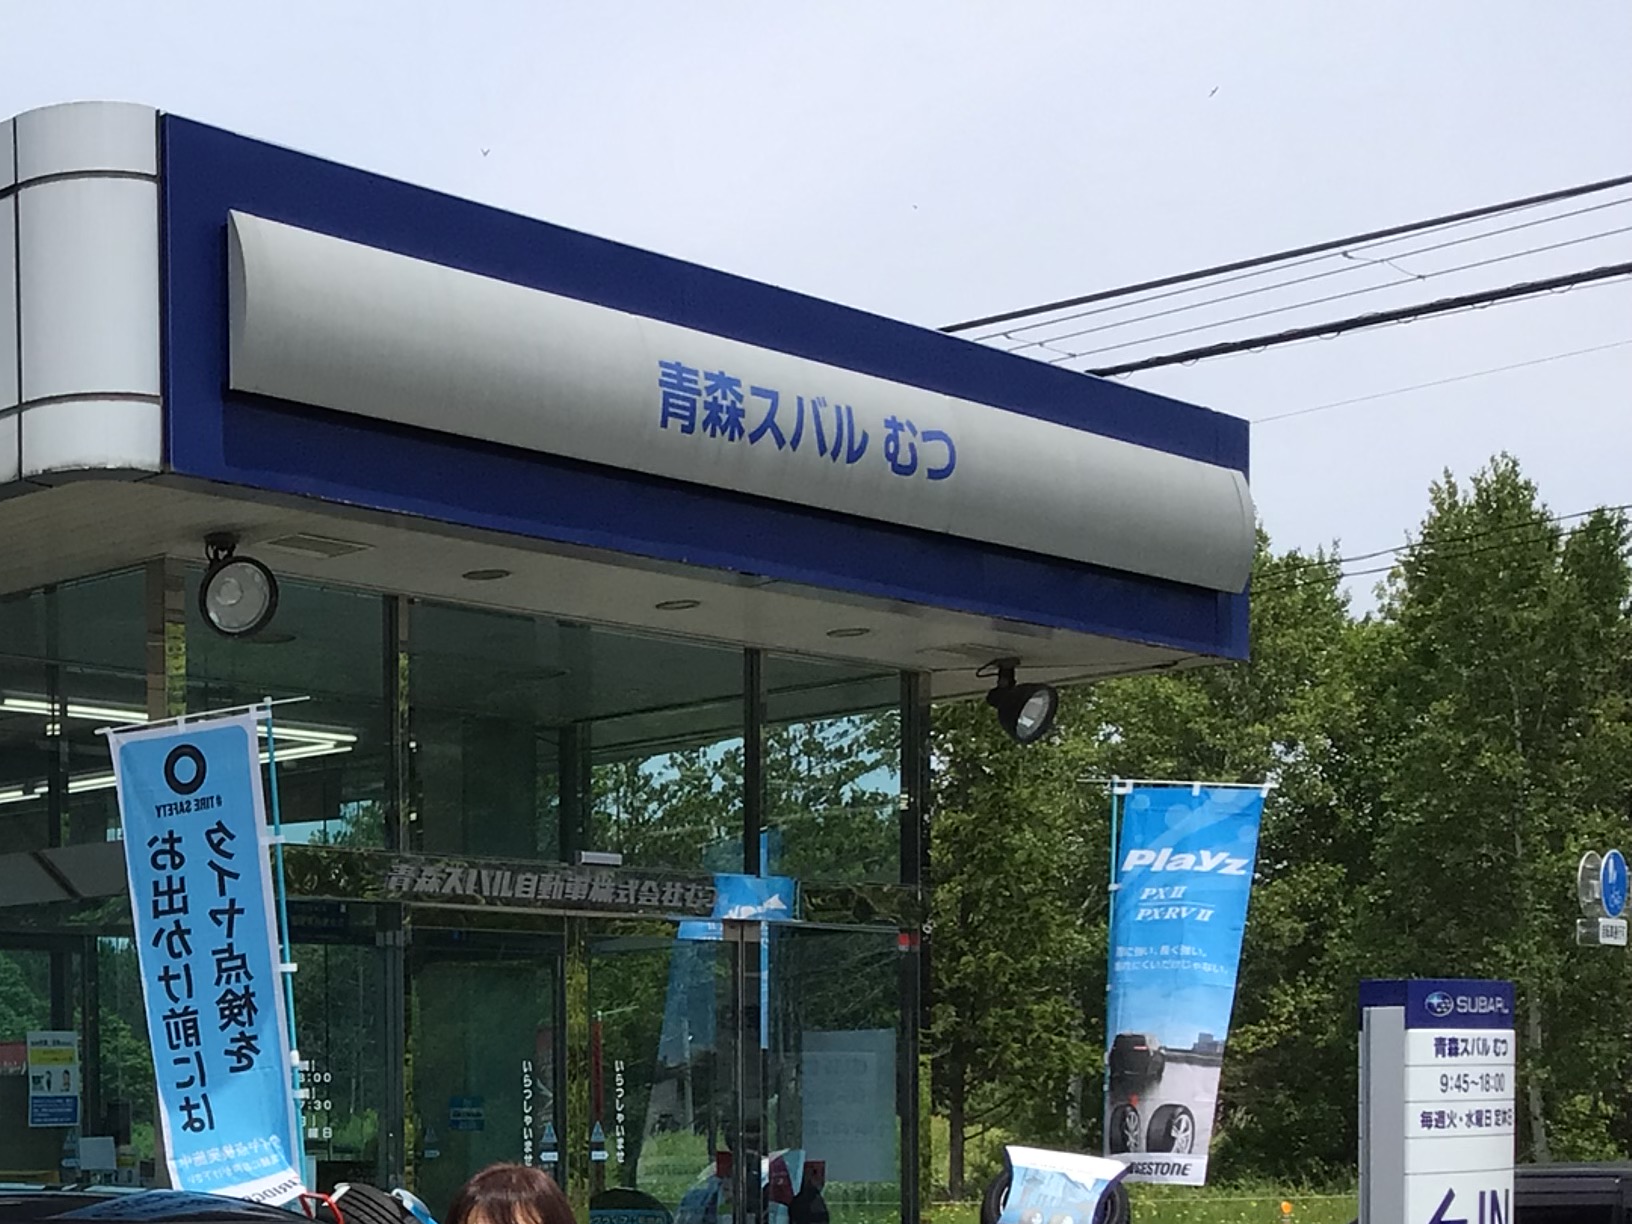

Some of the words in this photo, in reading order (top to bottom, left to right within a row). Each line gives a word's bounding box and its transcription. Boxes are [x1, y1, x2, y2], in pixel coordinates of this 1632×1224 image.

[658, 360, 869, 464] 青森スバル
[883, 415, 957, 481] むつ
[1434, 1036, 1490, 1058] 青森スバル
